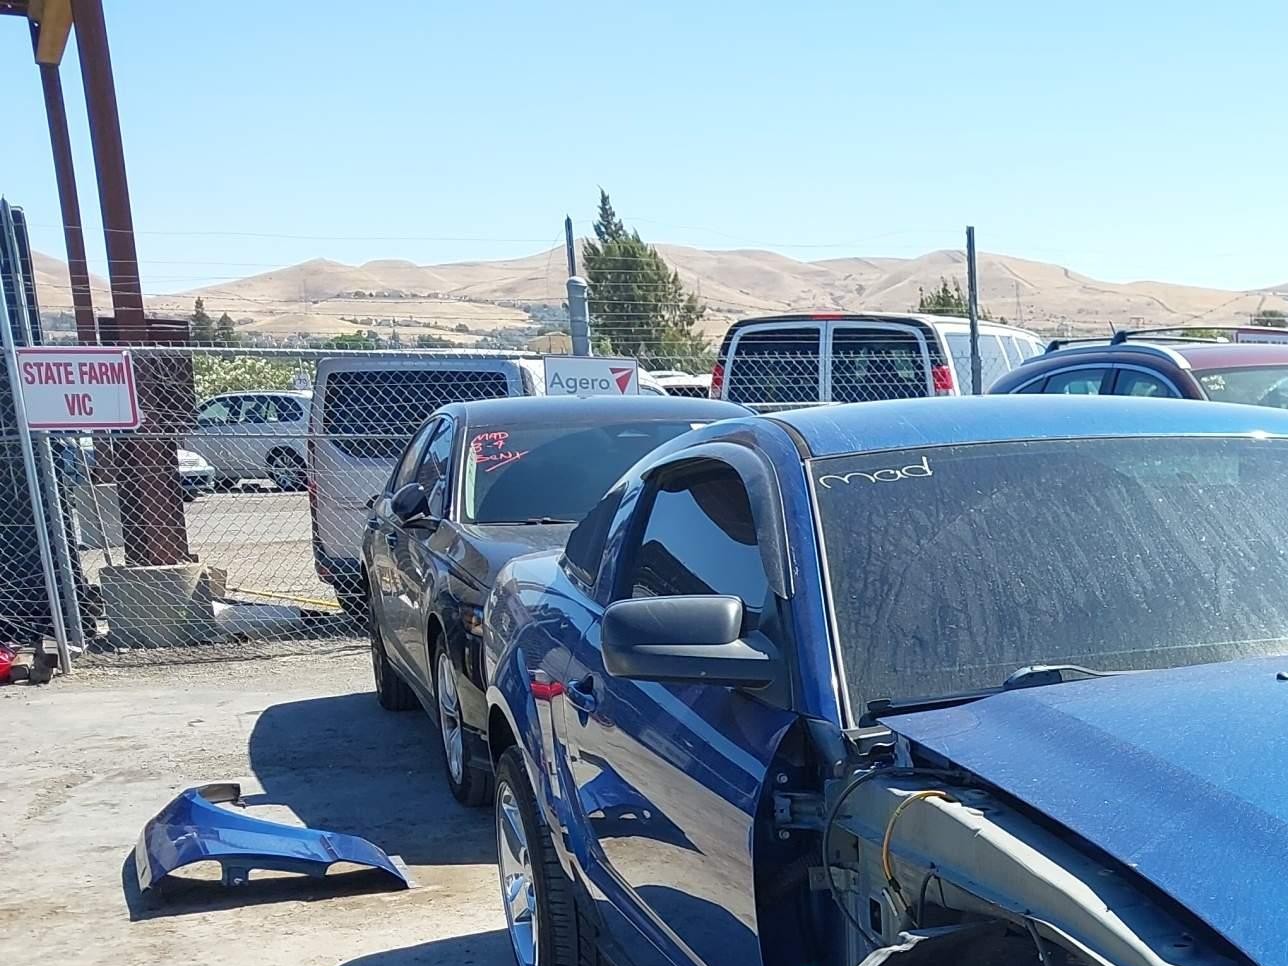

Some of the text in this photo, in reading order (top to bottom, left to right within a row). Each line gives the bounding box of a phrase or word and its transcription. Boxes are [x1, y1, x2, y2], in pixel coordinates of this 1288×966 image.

[24, 362, 126, 385] STATE FARM
[549, 372, 610, 394] Agero
[64, 393, 94, 416] VIC
[819, 456, 932, 488] mad
